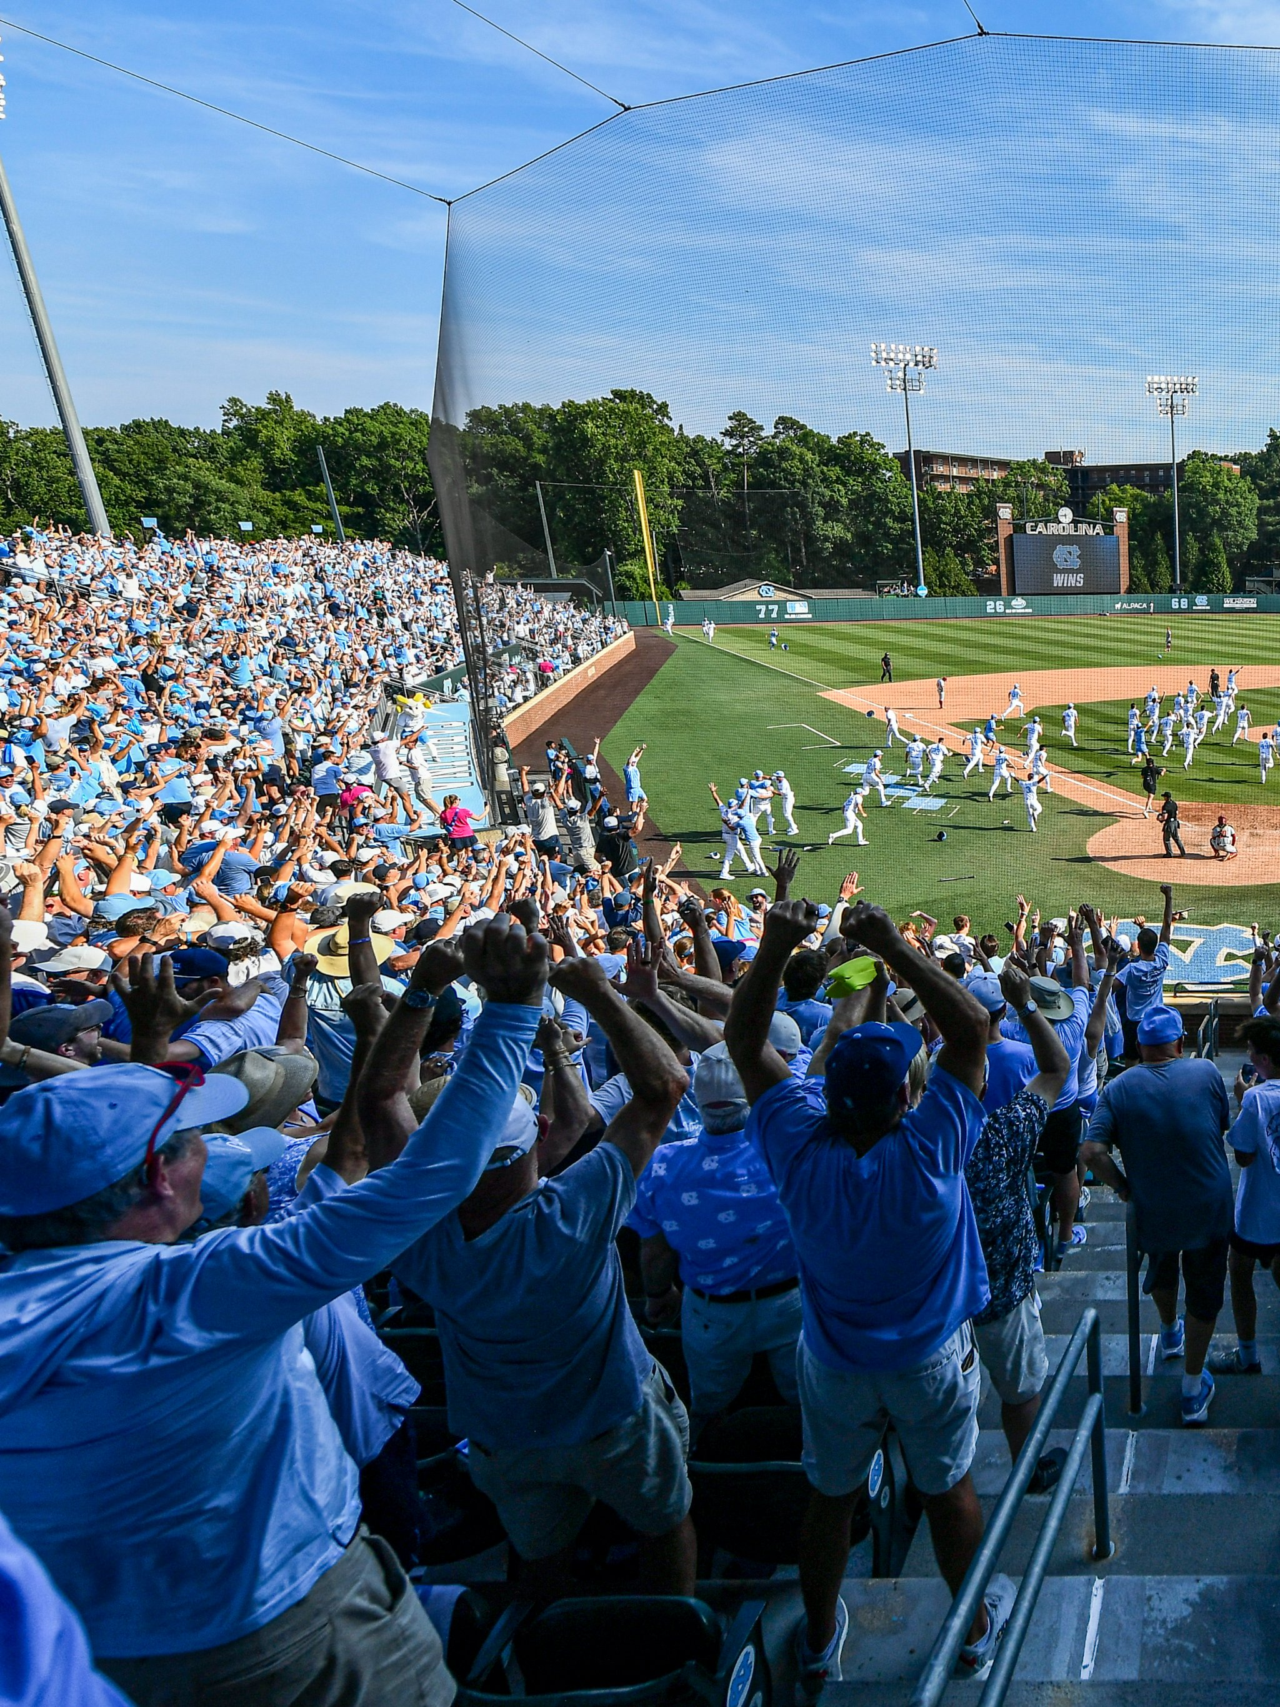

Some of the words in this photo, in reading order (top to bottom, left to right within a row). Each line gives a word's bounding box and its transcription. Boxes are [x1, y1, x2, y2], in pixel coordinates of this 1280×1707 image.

[1025, 522, 1105, 536] CAROLINA
[1053, 573, 1084, 587] WINS
[986, 601, 1004, 613] 26
[1172, 598, 1188, 609] 68
[756, 605, 779, 618] 77
